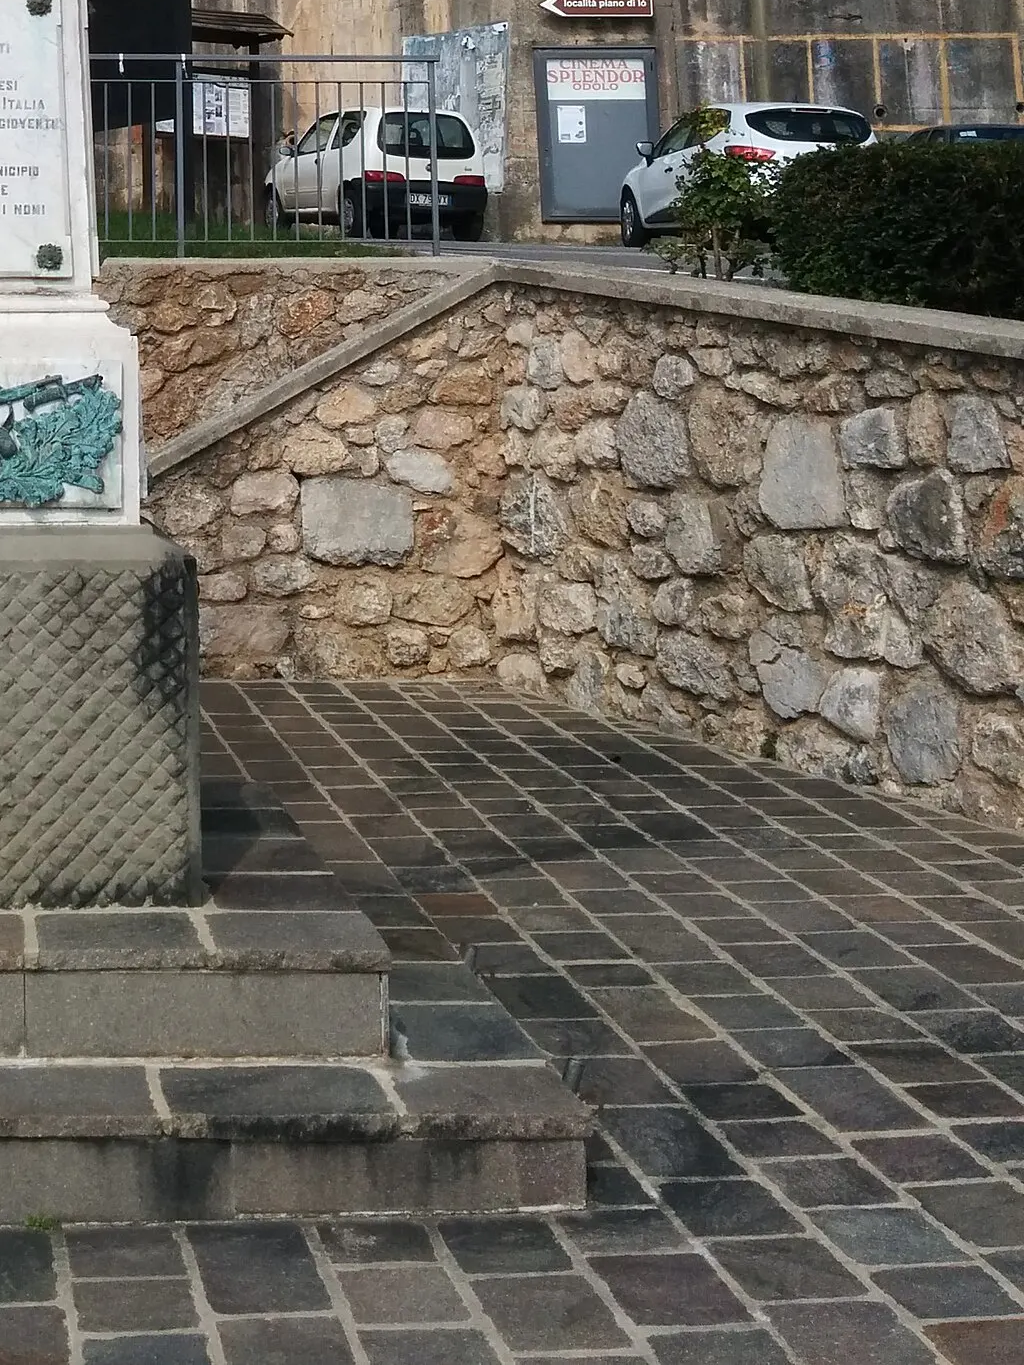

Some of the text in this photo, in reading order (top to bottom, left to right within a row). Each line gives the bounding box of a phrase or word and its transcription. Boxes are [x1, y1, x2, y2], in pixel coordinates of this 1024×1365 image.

[560, 59, 629, 70] CINEMA
[547, 69, 645, 84] SPLENDOR
[572, 83, 619, 91] ODOLO
[14, 204, 46, 215] NOMI
